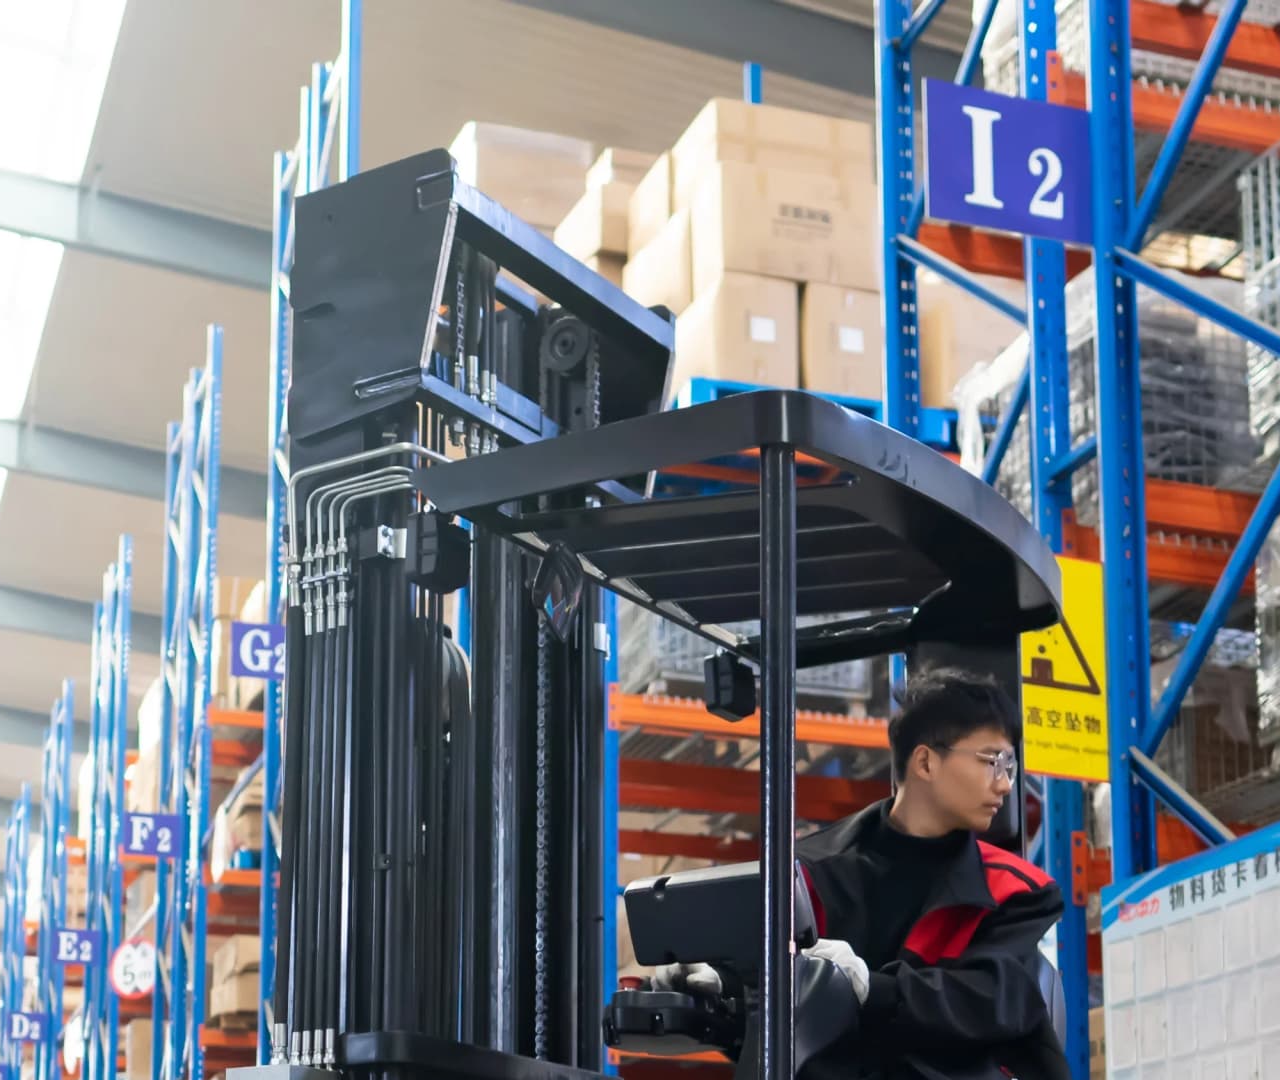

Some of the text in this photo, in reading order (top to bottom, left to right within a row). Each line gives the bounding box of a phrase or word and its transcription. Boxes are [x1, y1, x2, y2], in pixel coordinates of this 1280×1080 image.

[1025, 705, 1102, 736] 高空坠物
[129, 815, 172, 854] F2
[56, 930, 93, 962] E2
[10, 1013, 41, 1040] D2
